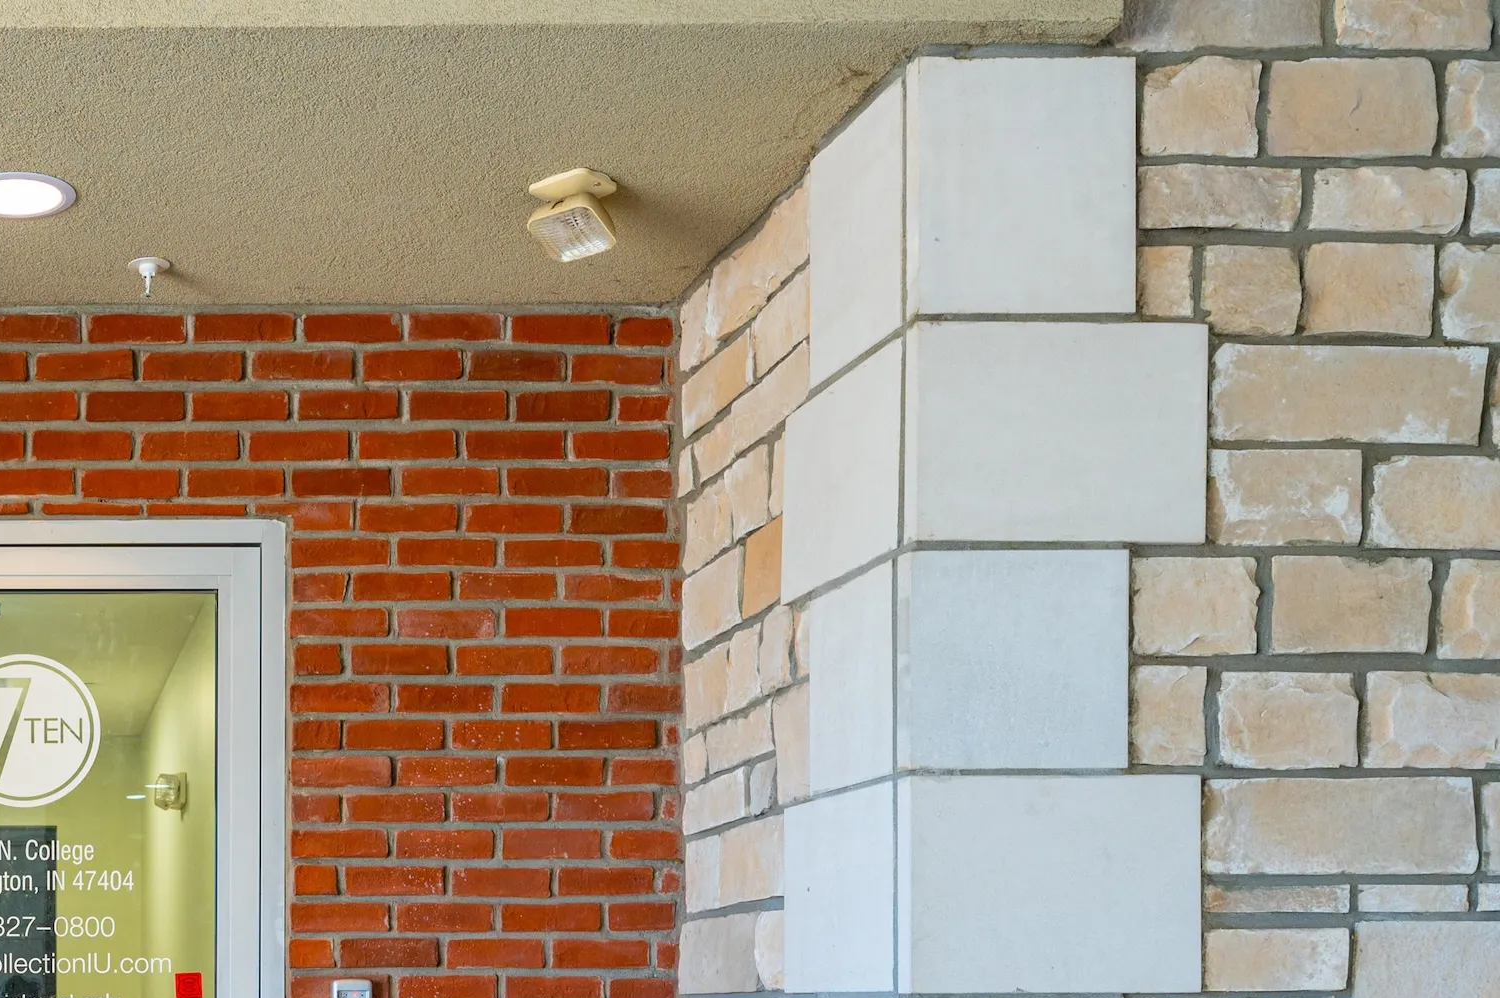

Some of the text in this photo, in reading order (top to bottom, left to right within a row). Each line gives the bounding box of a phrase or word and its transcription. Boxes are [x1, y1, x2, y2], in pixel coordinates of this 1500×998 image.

[23, 717, 83, 745] TEN
[25, 840, 95, 865] College
[46, 871, 66, 892] IN
[72, 871, 134, 891] 47404
